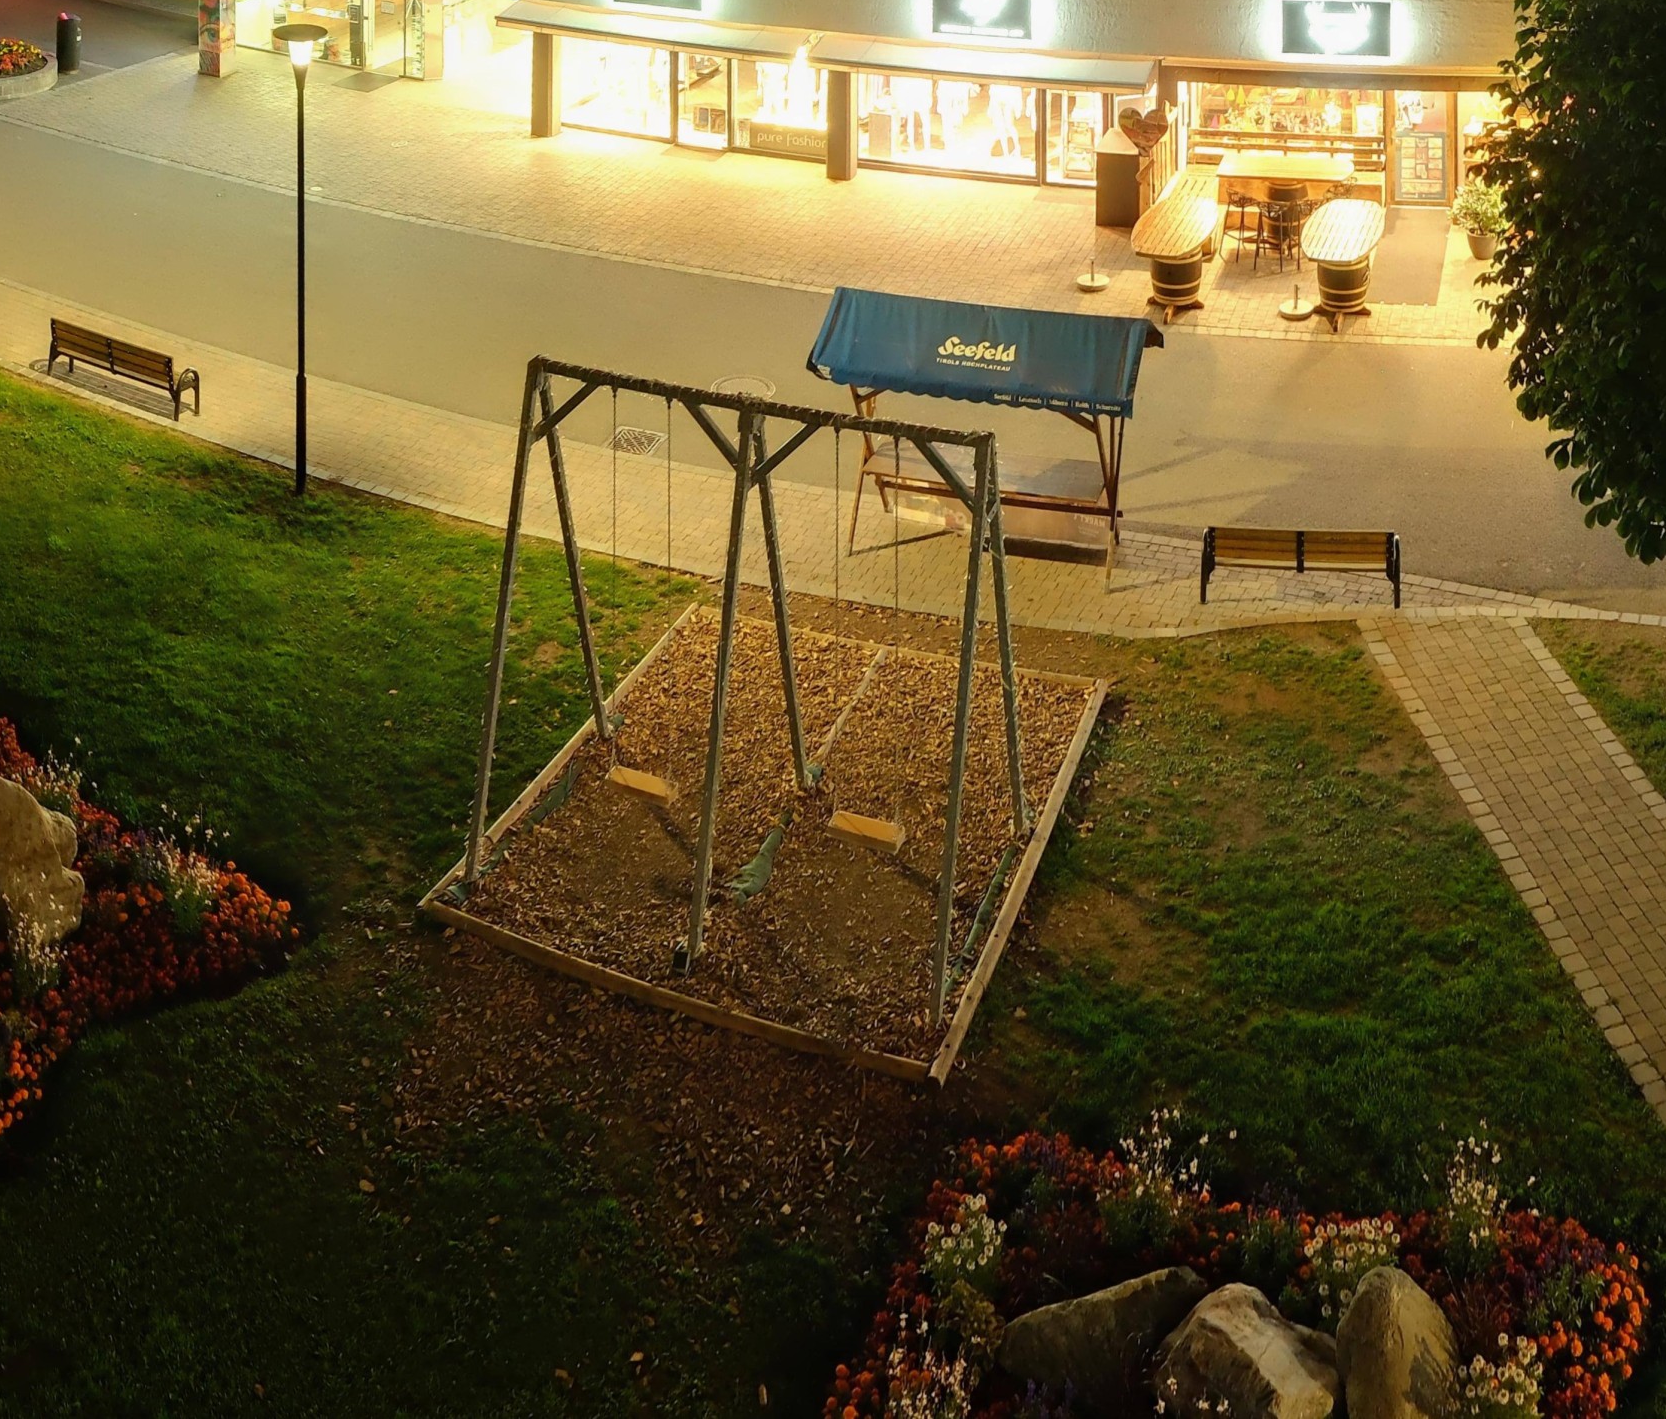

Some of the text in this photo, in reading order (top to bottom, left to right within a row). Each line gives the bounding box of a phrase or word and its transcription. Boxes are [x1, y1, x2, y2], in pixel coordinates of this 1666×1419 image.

[758, 132, 783, 146] pure
[938, 336, 1016, 362] Seefeld
[936, 356, 960, 366] TIROLS
